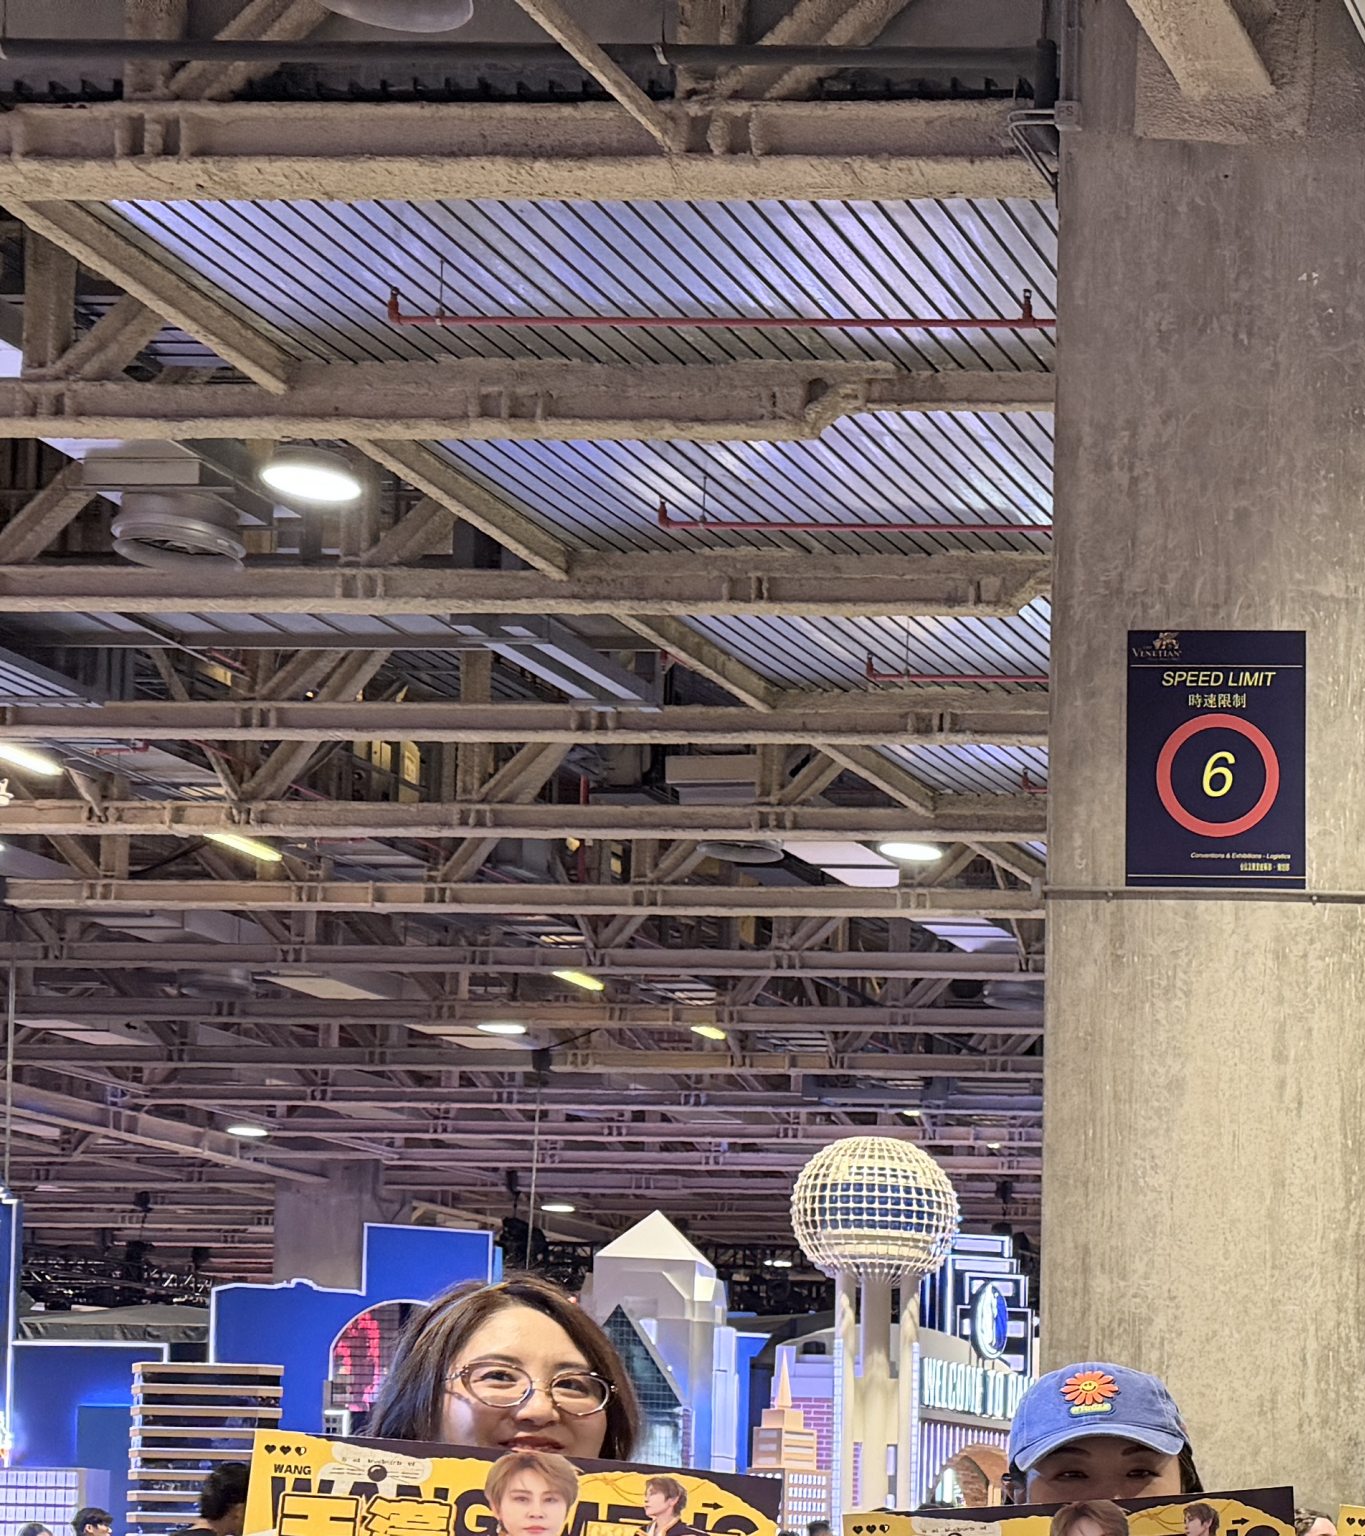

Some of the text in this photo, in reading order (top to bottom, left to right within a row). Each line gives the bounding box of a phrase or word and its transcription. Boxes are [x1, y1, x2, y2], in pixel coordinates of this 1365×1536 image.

[1162, 672, 1276, 687] SPEED LIMIT
[1188, 693, 1247, 709] 時速限制
[1202, 751, 1236, 797] 6
[922, 1356, 984, 1415] WELCOME
[986, 1368, 1005, 1419] TO
[274, 1464, 312, 1476] WANG
